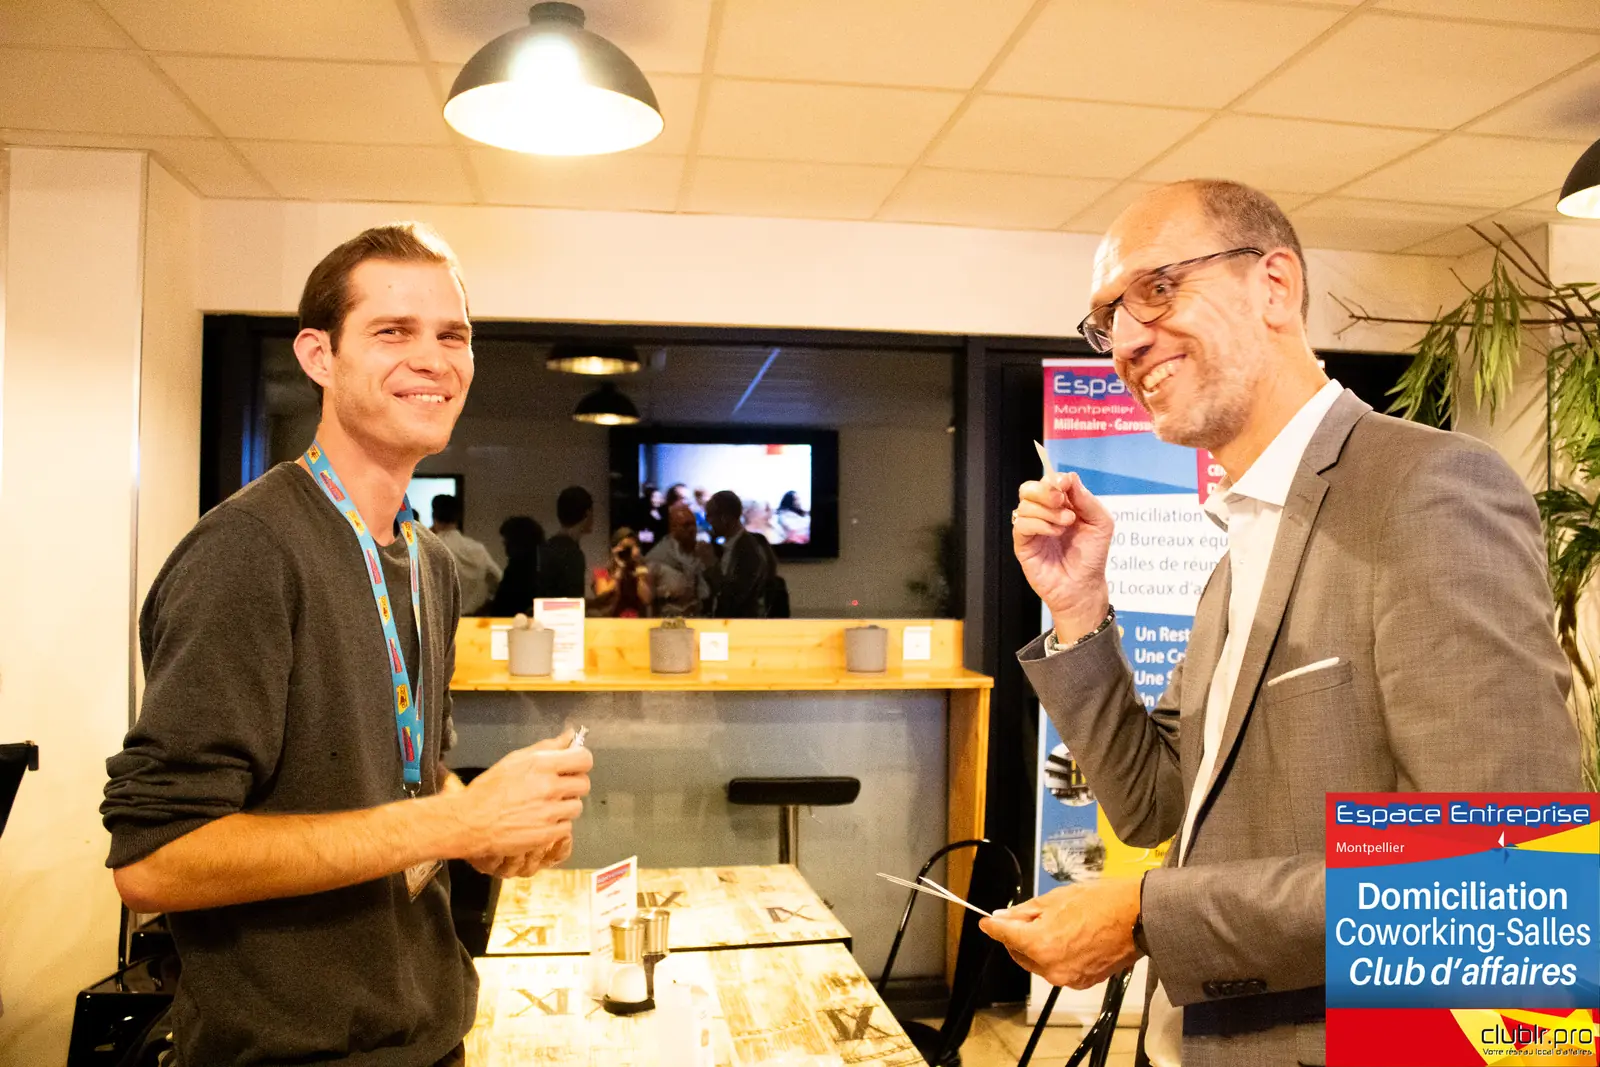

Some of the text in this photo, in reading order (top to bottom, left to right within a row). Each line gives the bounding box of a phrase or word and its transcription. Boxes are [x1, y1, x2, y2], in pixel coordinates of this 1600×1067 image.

[1054, 374, 1130, 398] Espa
[1054, 404, 1135, 415] Montpellier
[1053, 417, 1107, 431] Millénaire
[1111, 507, 1203, 523] omiciliation
[1130, 532, 1195, 547] Bureaux
[1110, 555, 1155, 571] Salles
[1159, 556, 1180, 572] de
[1120, 581, 1175, 596] Locaux
[1135, 625, 1157, 642] Un
[1134, 647, 1165, 664] Une
[1134, 670, 1164, 686] Une
